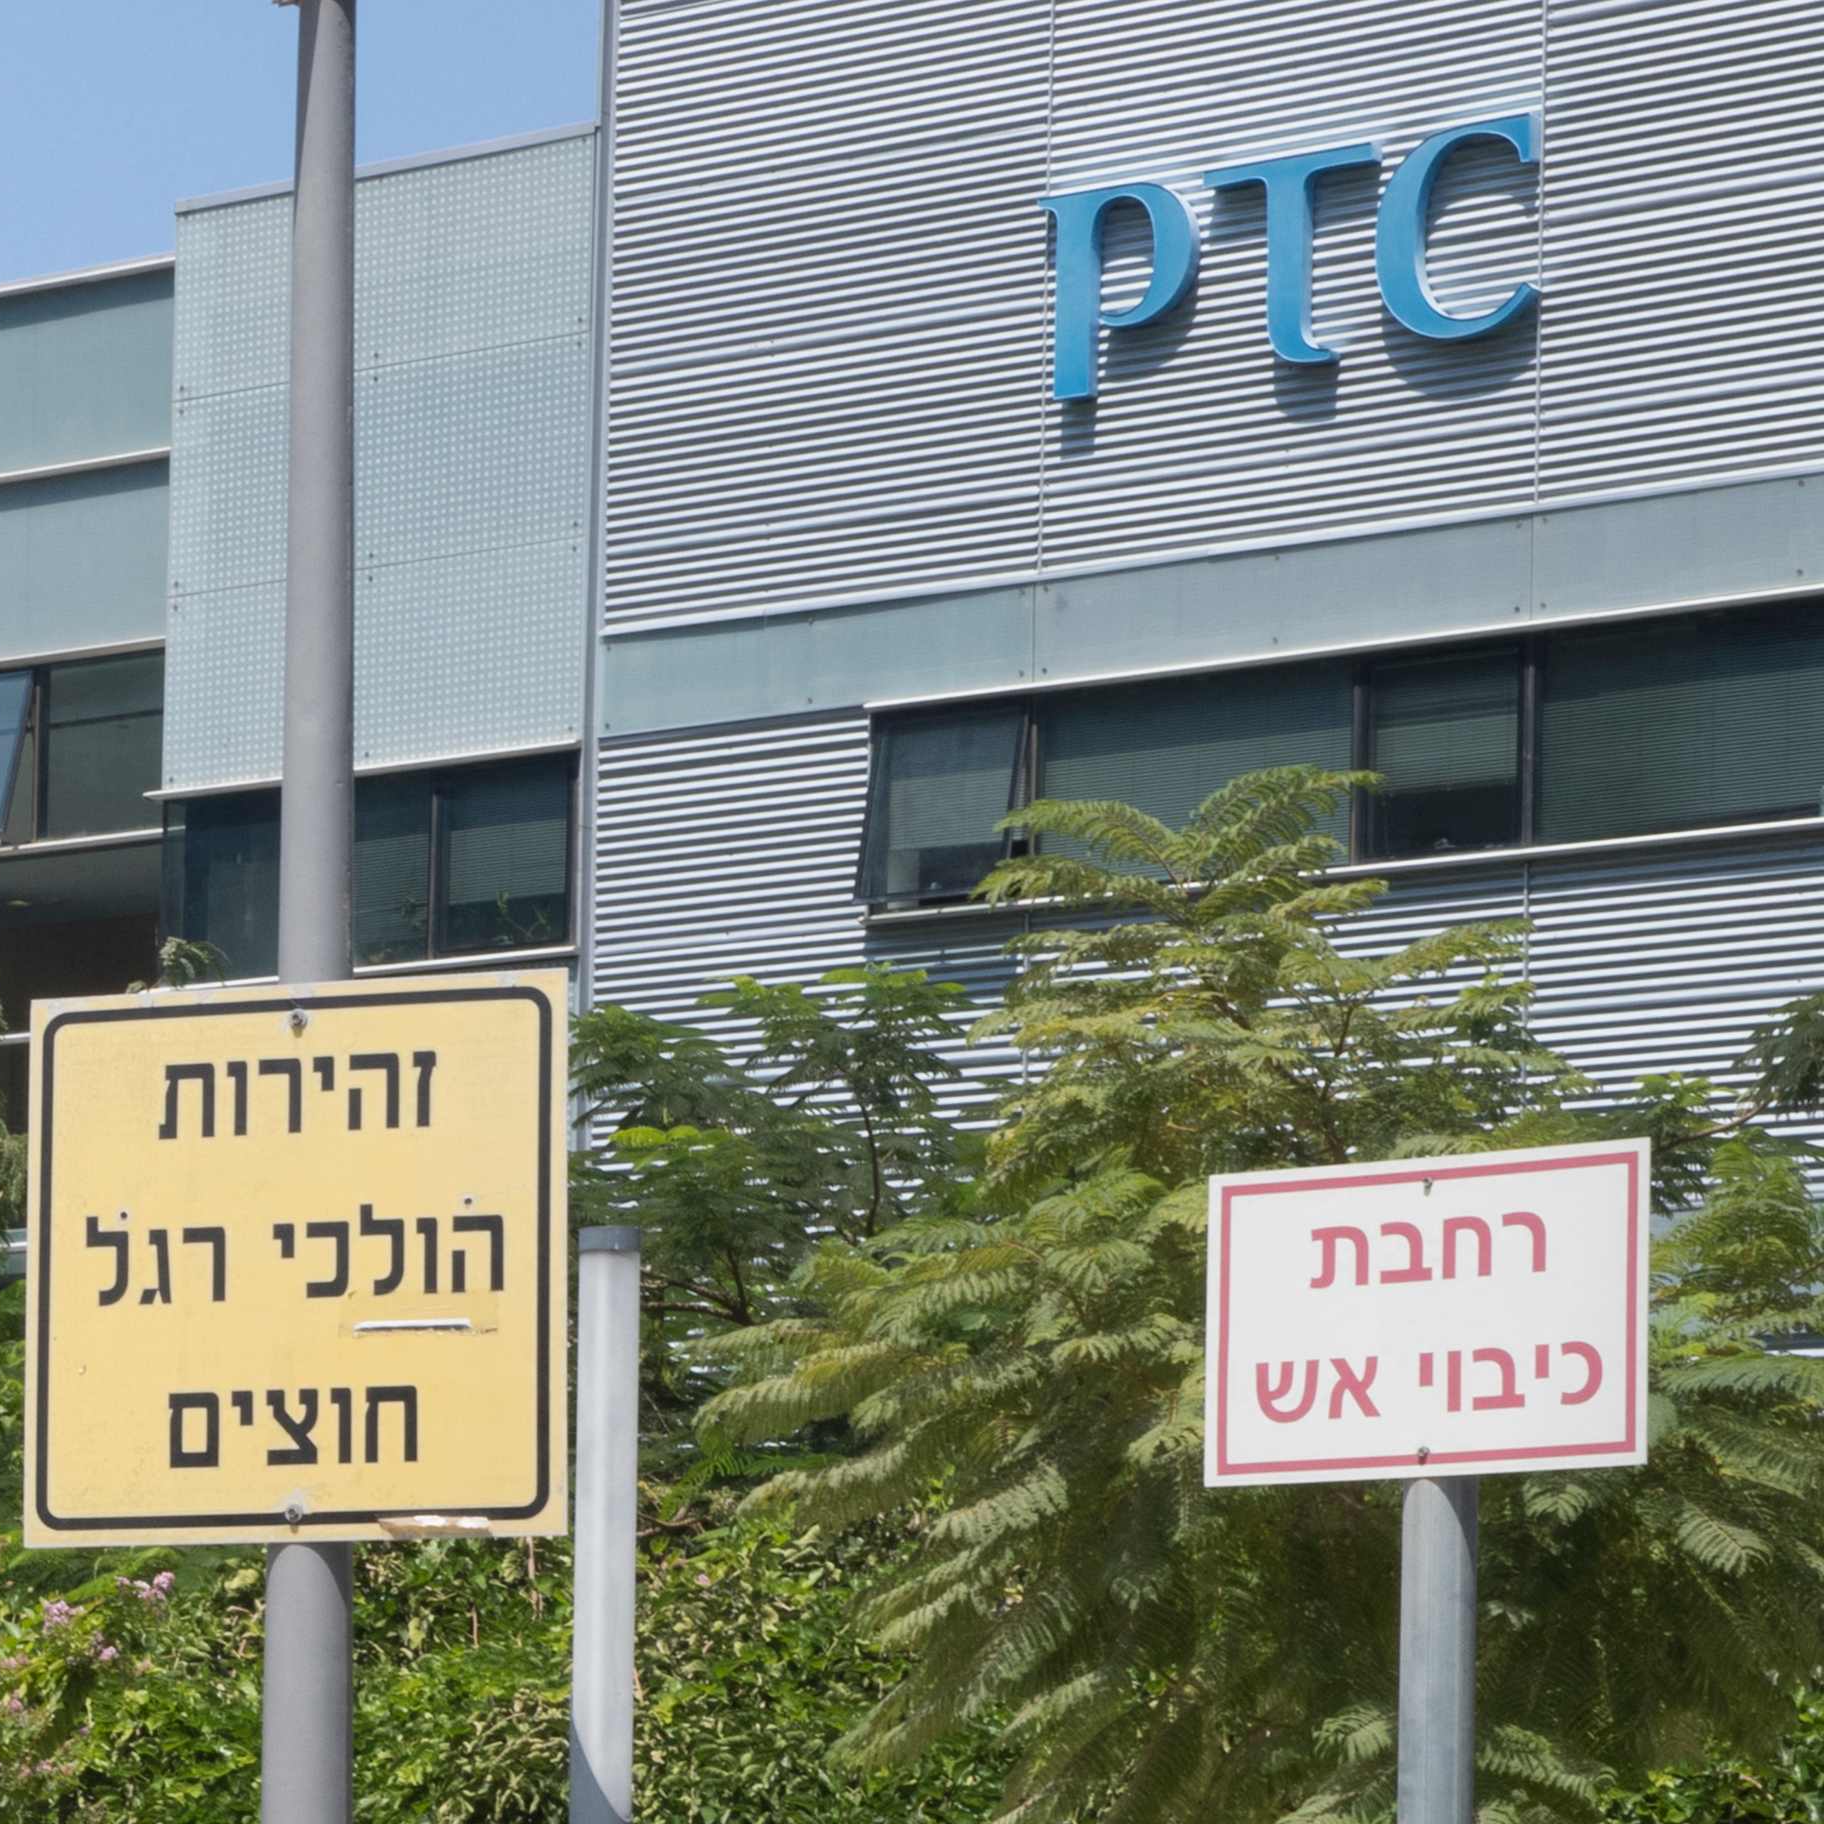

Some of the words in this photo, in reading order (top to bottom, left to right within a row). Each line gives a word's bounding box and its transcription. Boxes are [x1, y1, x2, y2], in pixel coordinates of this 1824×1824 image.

[1037, 111, 1542, 399] PTC
[158, 1050, 437, 1140] זהירות
[86, 1216, 226, 1306] רגל
[272, 1204, 504, 1298] הולכי
[1310, 1211, 1547, 1289] רחבת
[1255, 1355, 1381, 1424] אש
[1419, 1340, 1603, 1412] כיבוי
[168, 1385, 418, 1468] חוצים
